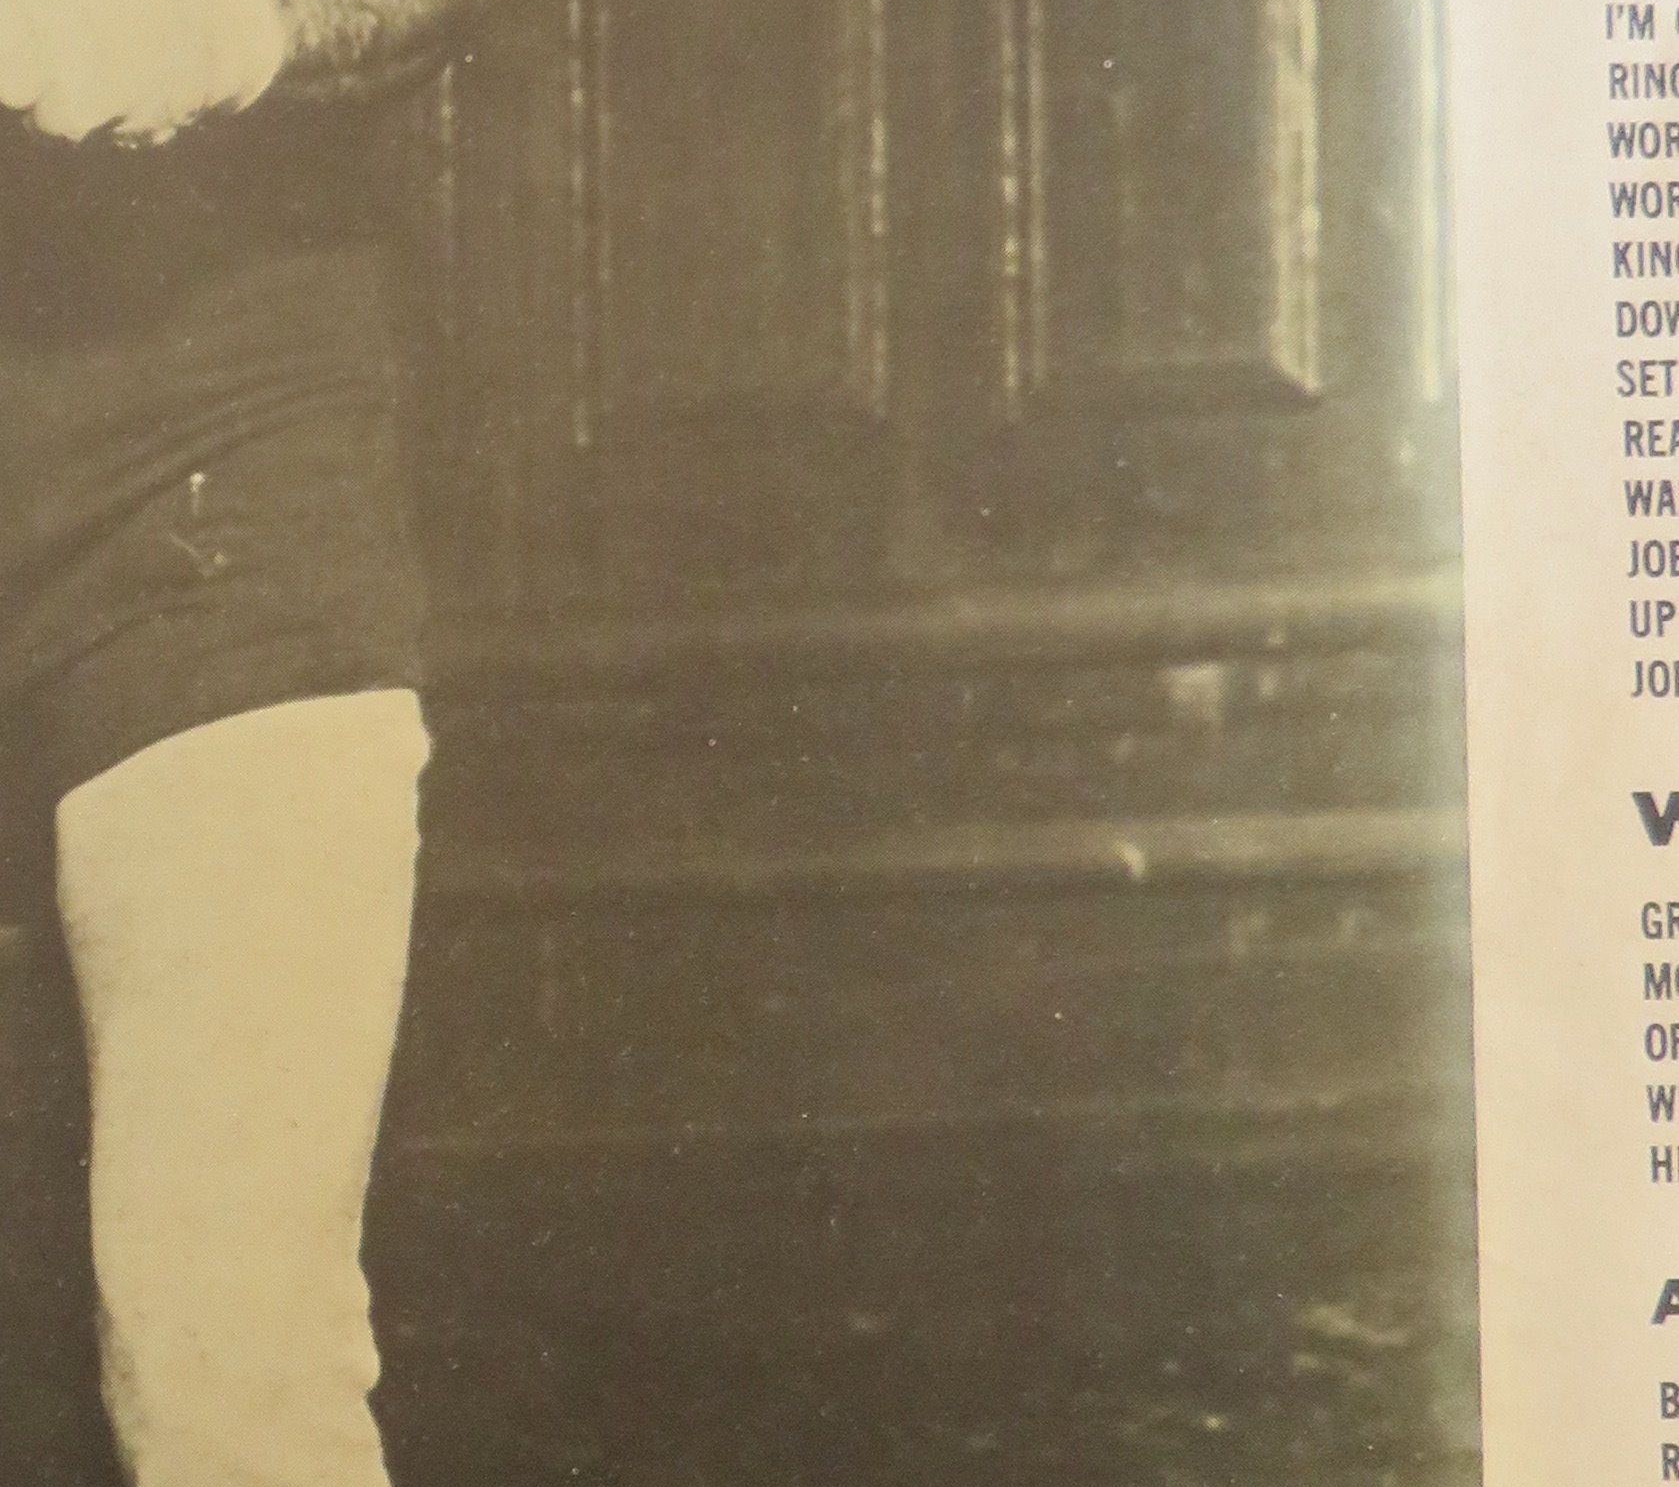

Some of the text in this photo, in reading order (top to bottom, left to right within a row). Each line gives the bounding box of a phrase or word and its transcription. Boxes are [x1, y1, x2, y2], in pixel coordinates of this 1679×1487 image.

[1606, 4, 1656, 41] I'M
[1616, 359, 1678, 397] SET
[1630, 599, 1677, 638] UP
